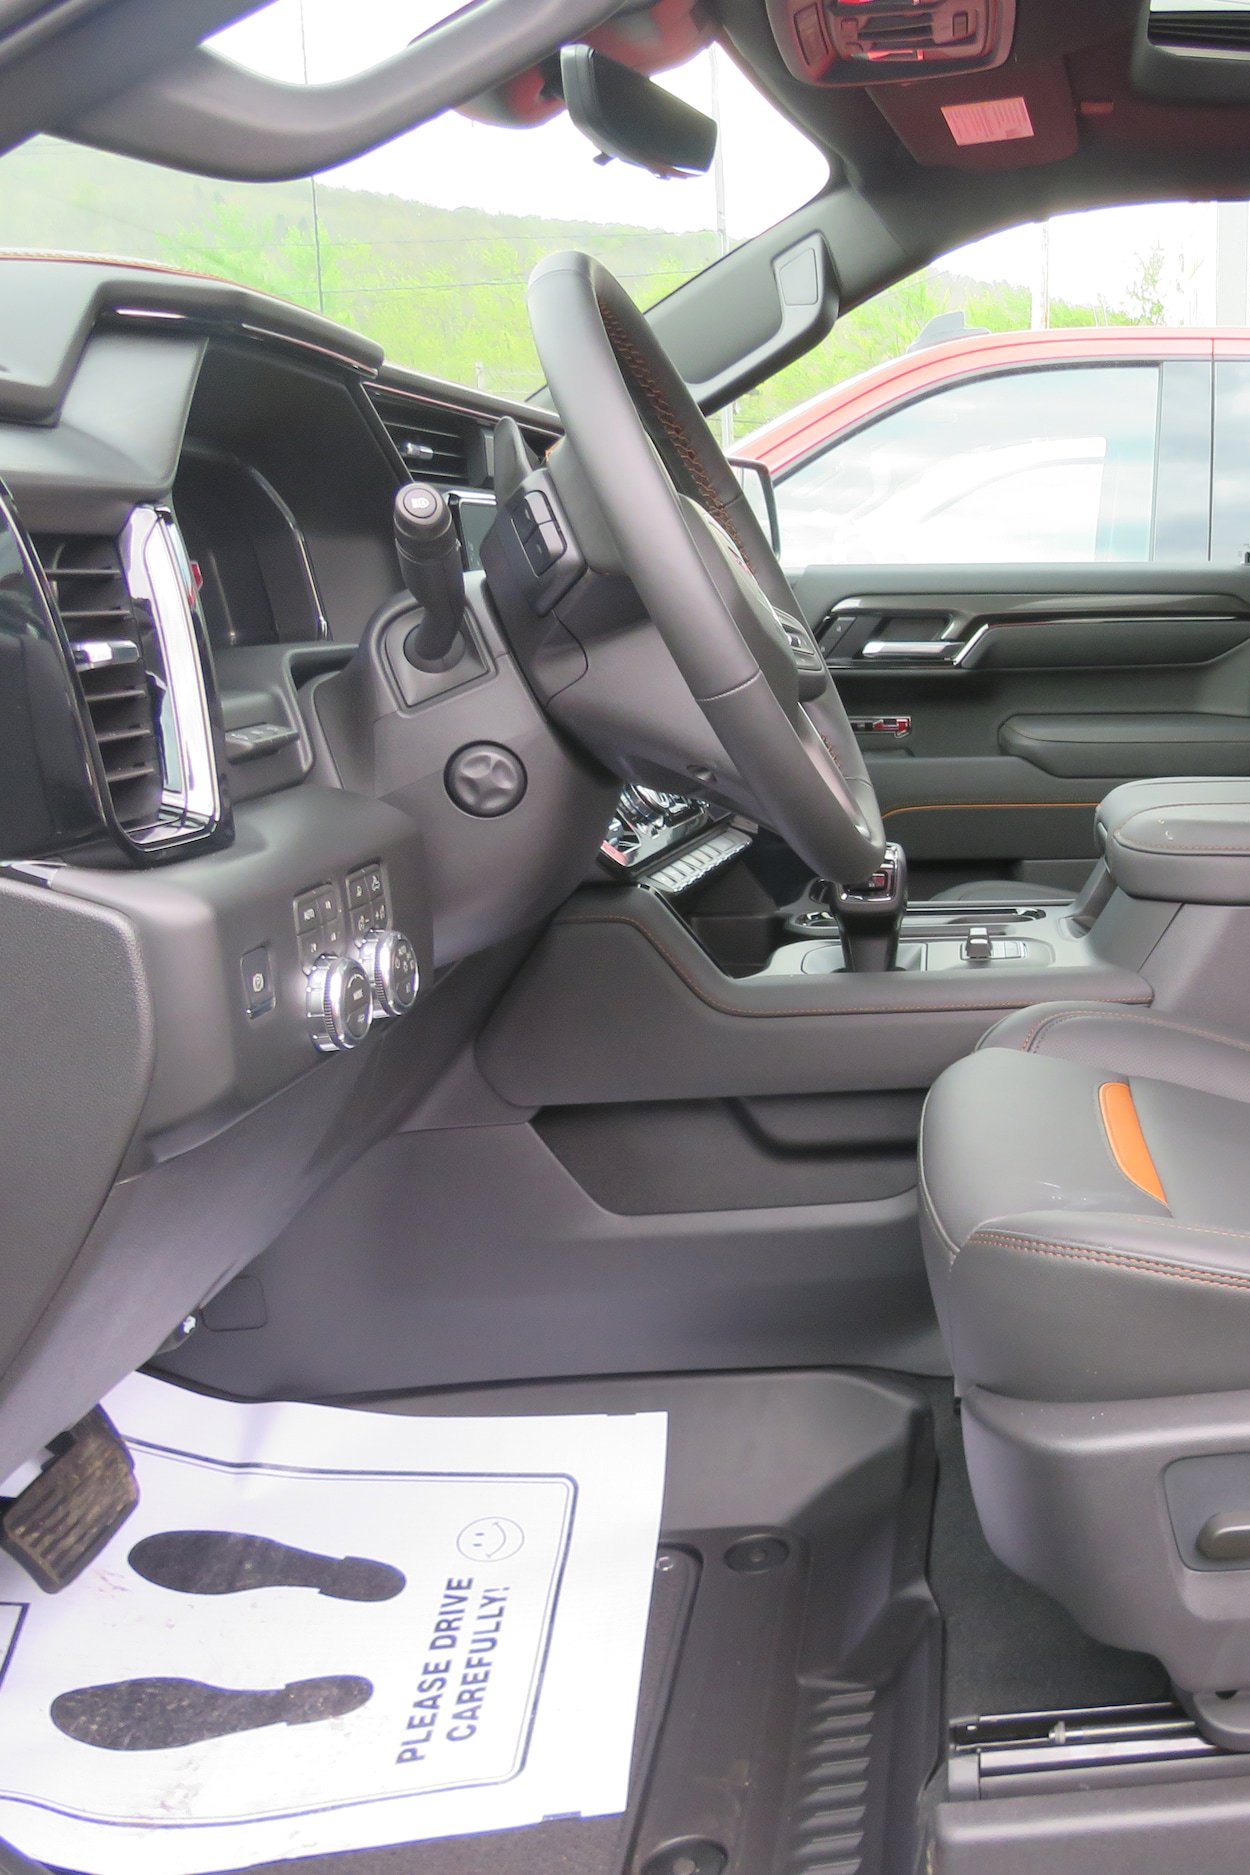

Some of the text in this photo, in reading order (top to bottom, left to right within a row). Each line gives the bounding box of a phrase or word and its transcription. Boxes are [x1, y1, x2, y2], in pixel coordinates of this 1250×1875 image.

[395, 1577, 474, 1765] PLEASE DRIVE
[445, 1586, 511, 1742] CAREFULLY!
